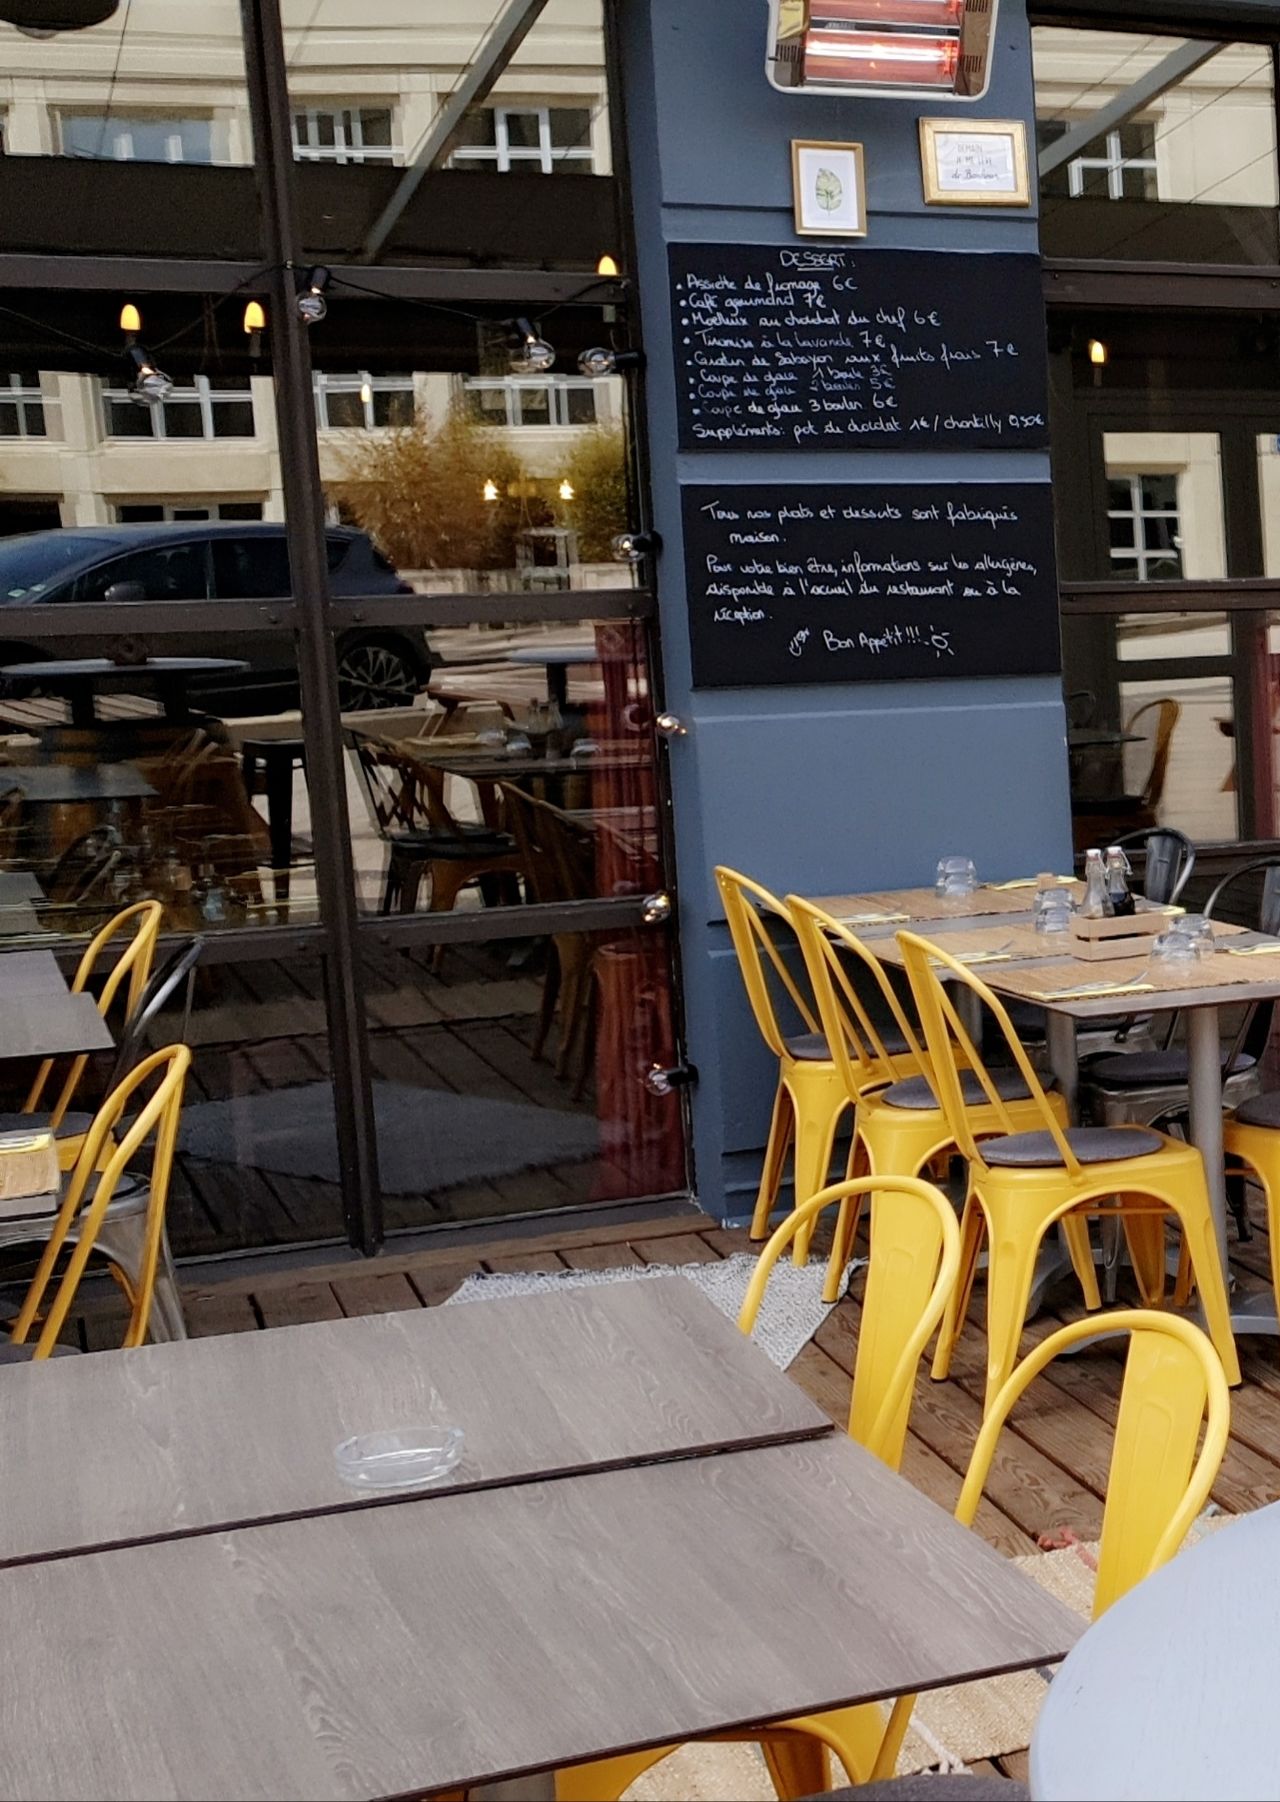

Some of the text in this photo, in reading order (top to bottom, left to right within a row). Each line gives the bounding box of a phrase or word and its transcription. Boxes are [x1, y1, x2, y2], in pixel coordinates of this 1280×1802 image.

[687, 273, 737, 290] Assiette
[744, 275, 761, 291] de
[766, 272, 821, 297] fromage
[689, 292, 718, 313] Café
[759, 317, 781, 327] au
[785, 308, 840, 326] chocolat
[847, 310, 870, 325] du
[876, 307, 906, 333] chef
[761, 335, 774, 348] à
[776, 331, 793, 347] la
[694, 351, 745, 366] Gratin
[752, 353, 770, 366] de
[845, 352, 880, 363] aux
[891, 343, 935, 368] fruits
[940, 343, 981, 370] frais
[699, 368, 738, 387] Coupe
[743, 371, 760, 383] de
[763, 370, 798, 387] glace
[812, 367, 823, 380] 1
[697, 384, 737, 402] Coupe
[743, 386, 760, 397] de
[748, 400, 764, 414] de
[793, 421, 820, 443] pot
[824, 420, 845, 434] de
[847, 415, 902, 433] chocolat
[944, 413, 1002, 434] chantilly
[700, 500, 740, 521] Tous
[746, 508, 773, 519] nos
[777, 502, 815, 525] plats
[819, 504, 837, 519] et
[911, 503, 940, 520] sont
[706, 553, 733, 573] Pour
[739, 558, 774, 575] votre
[775, 559, 804, 575] bien
[840, 550, 922, 582] informations
[927, 560, 949, 572] sur
[950, 551, 969, 569] les
[782, 581, 797, 596] à
[858, 579, 880, 595] du
[886, 578, 955, 597] restaurant
[962, 585, 983, 597] ou
[985, 579, 999, 595] à
[1001, 578, 1022, 597] la
[822, 628, 855, 652] Bon
